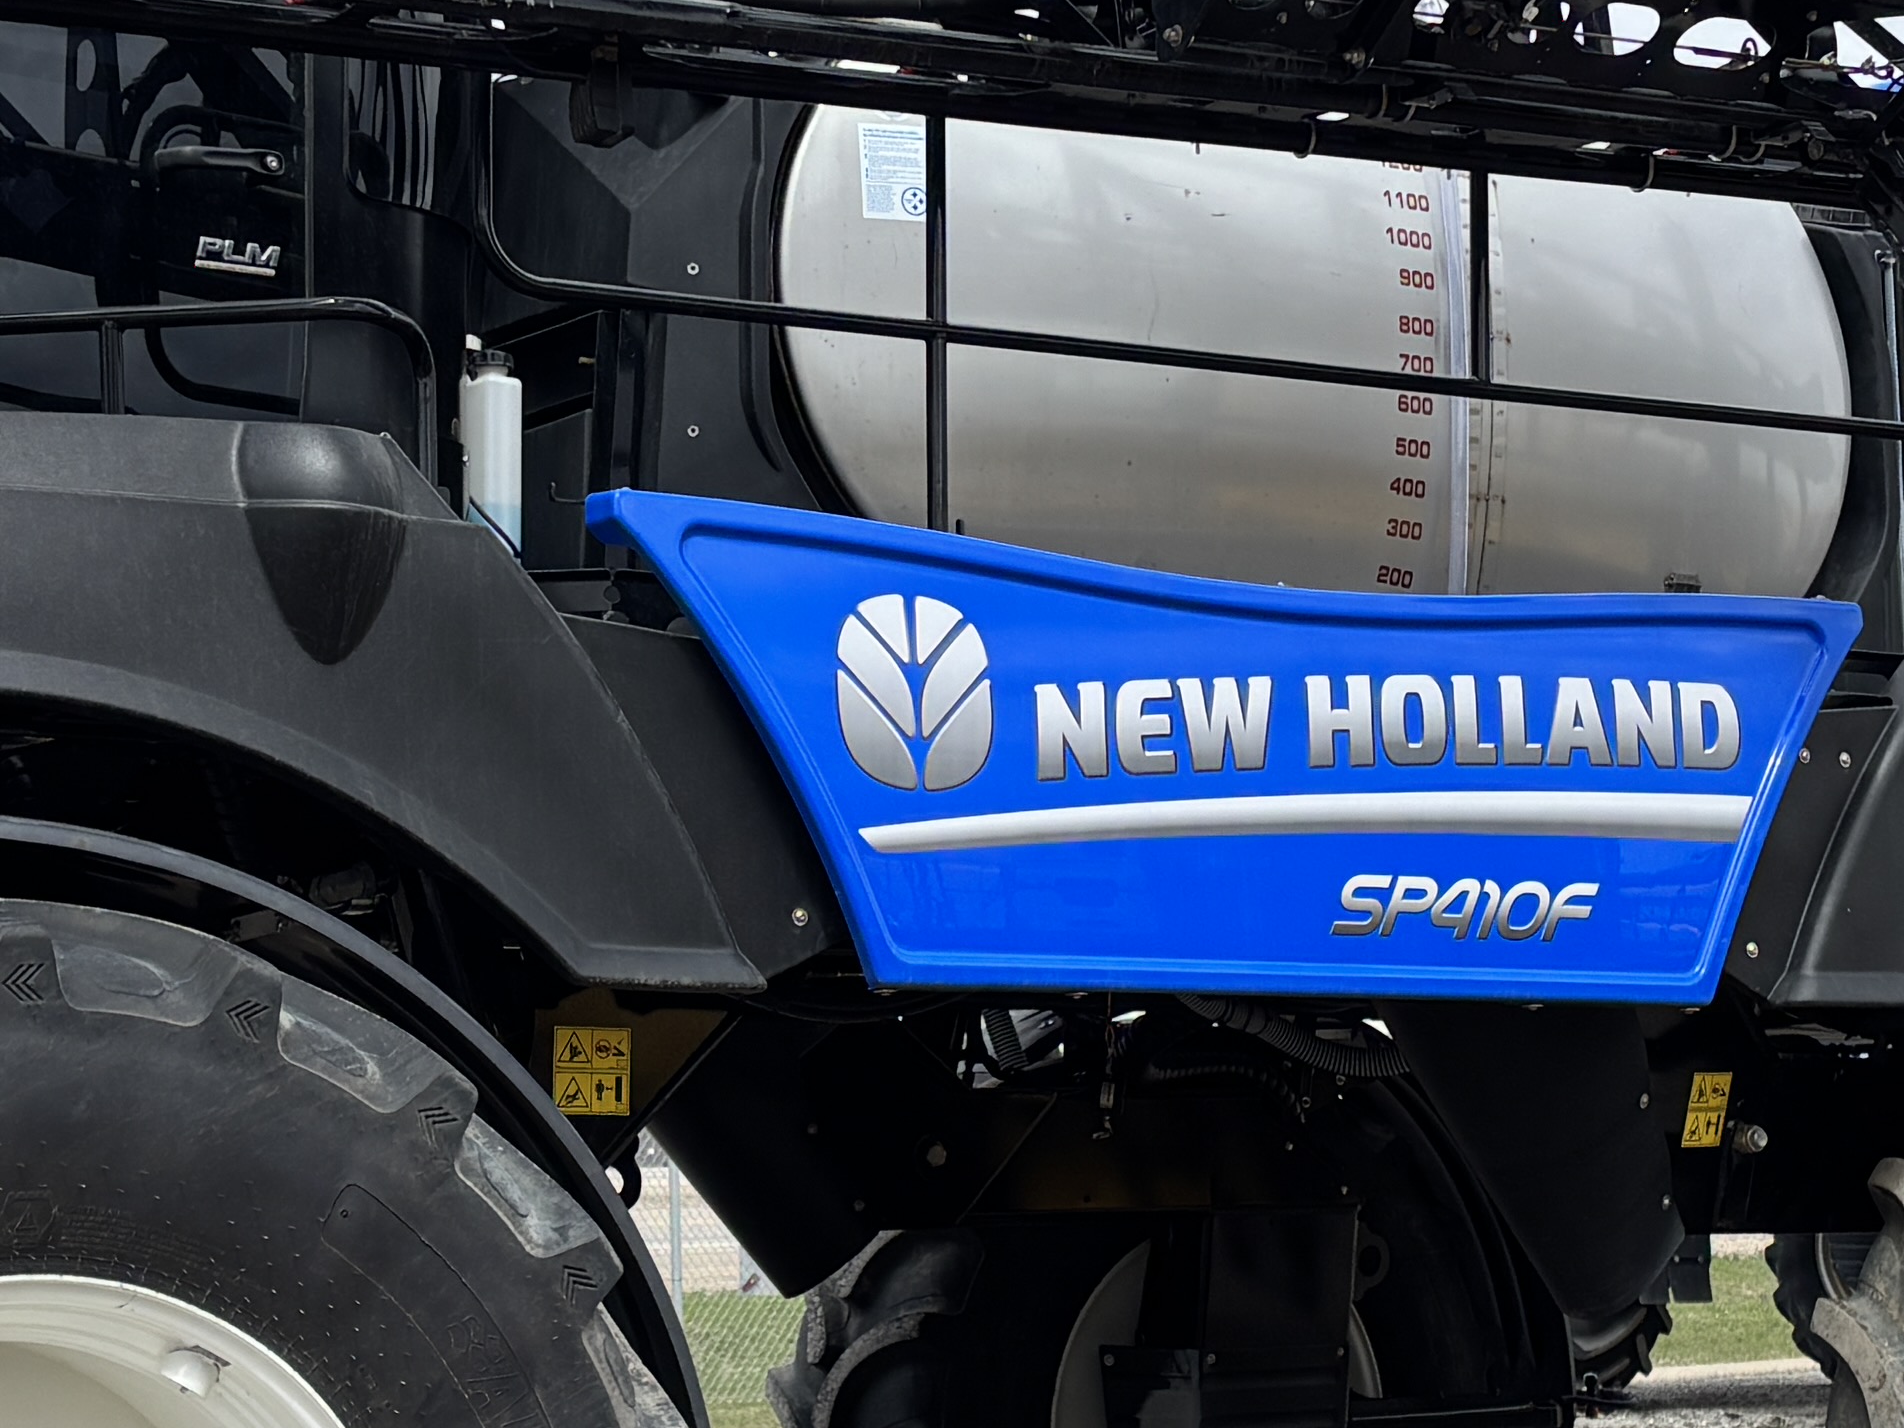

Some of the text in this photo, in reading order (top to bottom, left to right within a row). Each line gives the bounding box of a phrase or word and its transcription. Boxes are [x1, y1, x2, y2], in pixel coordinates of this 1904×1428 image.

[1383, 189, 1430, 213] 1100
[1385, 226, 1432, 251] 1000
[196, 235, 281, 267] PLM
[1399, 268, 1435, 291] 900
[1398, 315, 1434, 337] 800
[1399, 353, 1434, 374] 700
[1398, 393, 1433, 416] 600
[1395, 436, 1431, 460] 500
[1389, 476, 1426, 499] 400
[1386, 518, 1423, 541] 300
[1376, 565, 1414, 589] 200
[1034, 674, 1741, 781] NEW HOLLAND
[1330, 875, 1600, 942] SP410F
